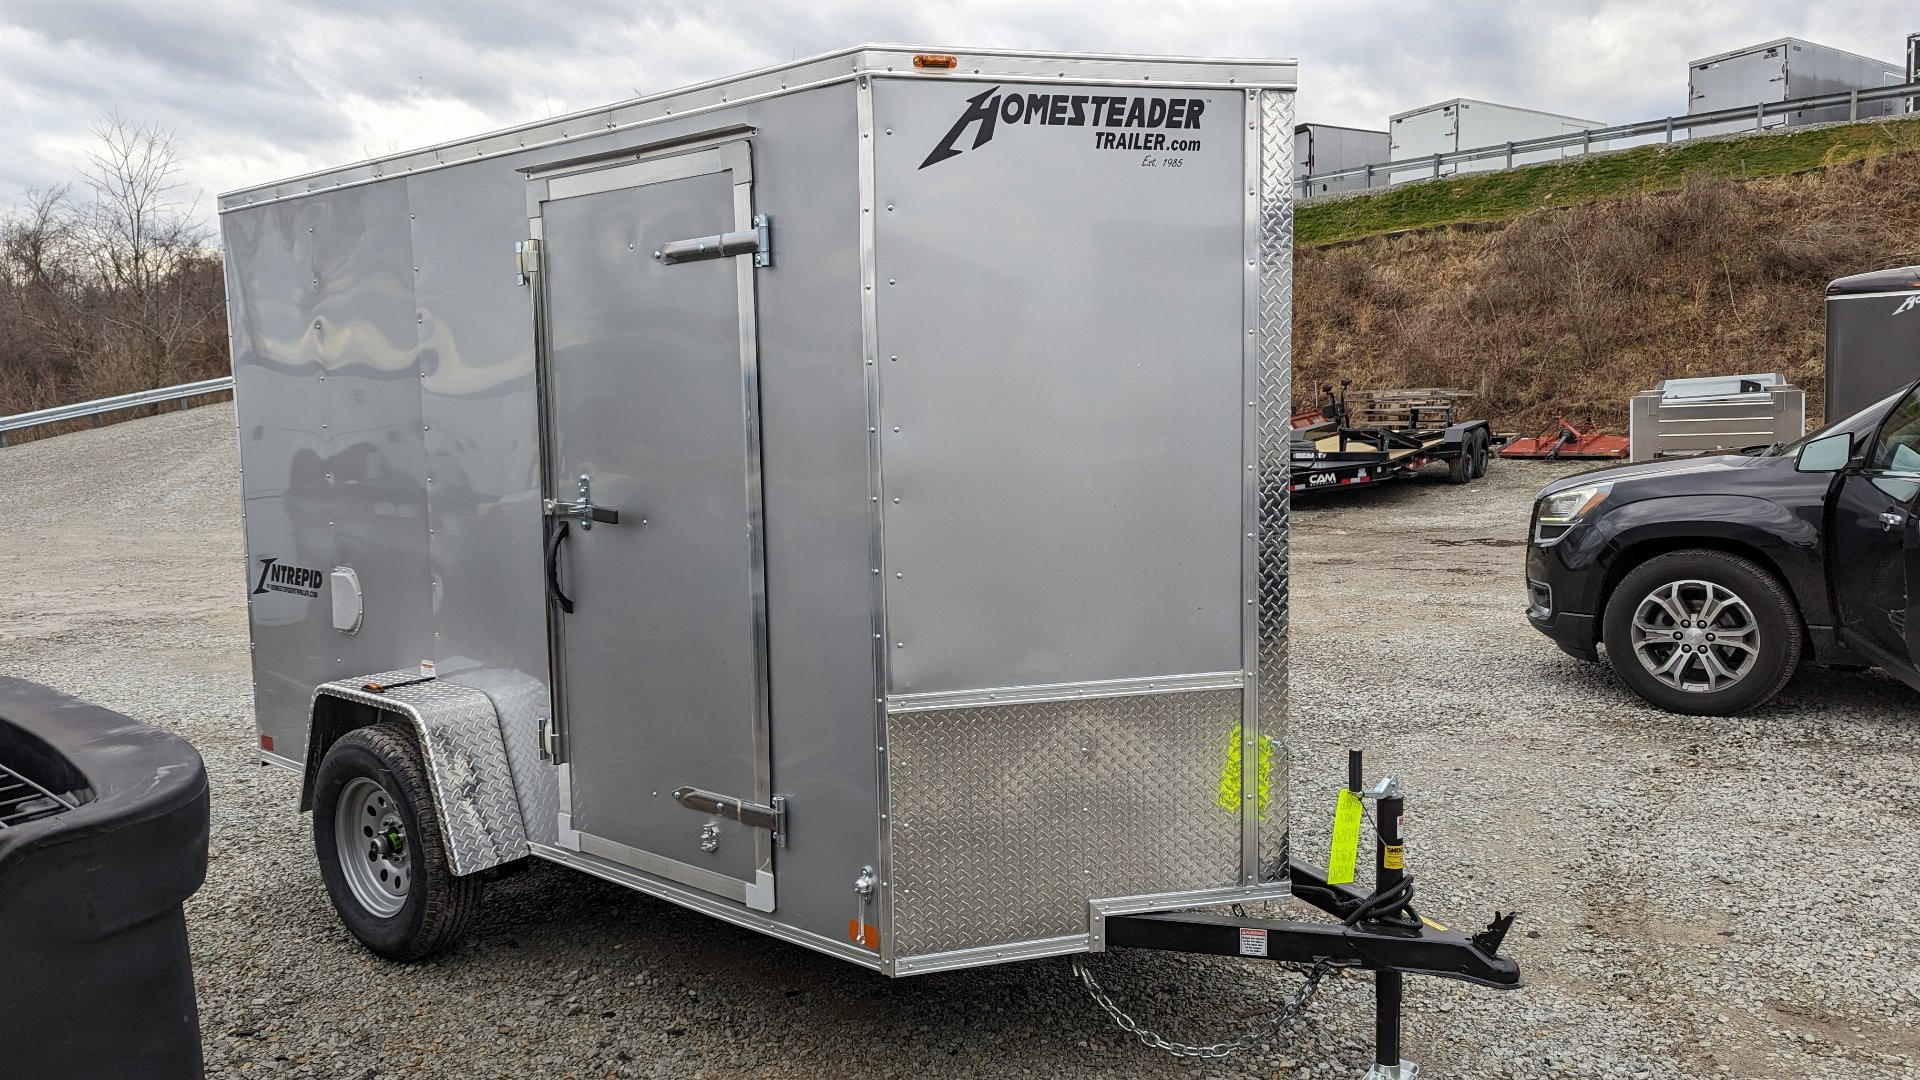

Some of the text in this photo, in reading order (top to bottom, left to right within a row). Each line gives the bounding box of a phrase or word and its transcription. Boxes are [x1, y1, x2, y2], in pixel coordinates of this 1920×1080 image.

[918, 85, 1205, 170] HOMESTEADER
[1095, 131, 1200, 152] TRAILER.com
[1141, 154, 1183, 168] Est. 1985
[1309, 472, 1336, 483] CAM
[252, 557, 322, 594] INTREPID
